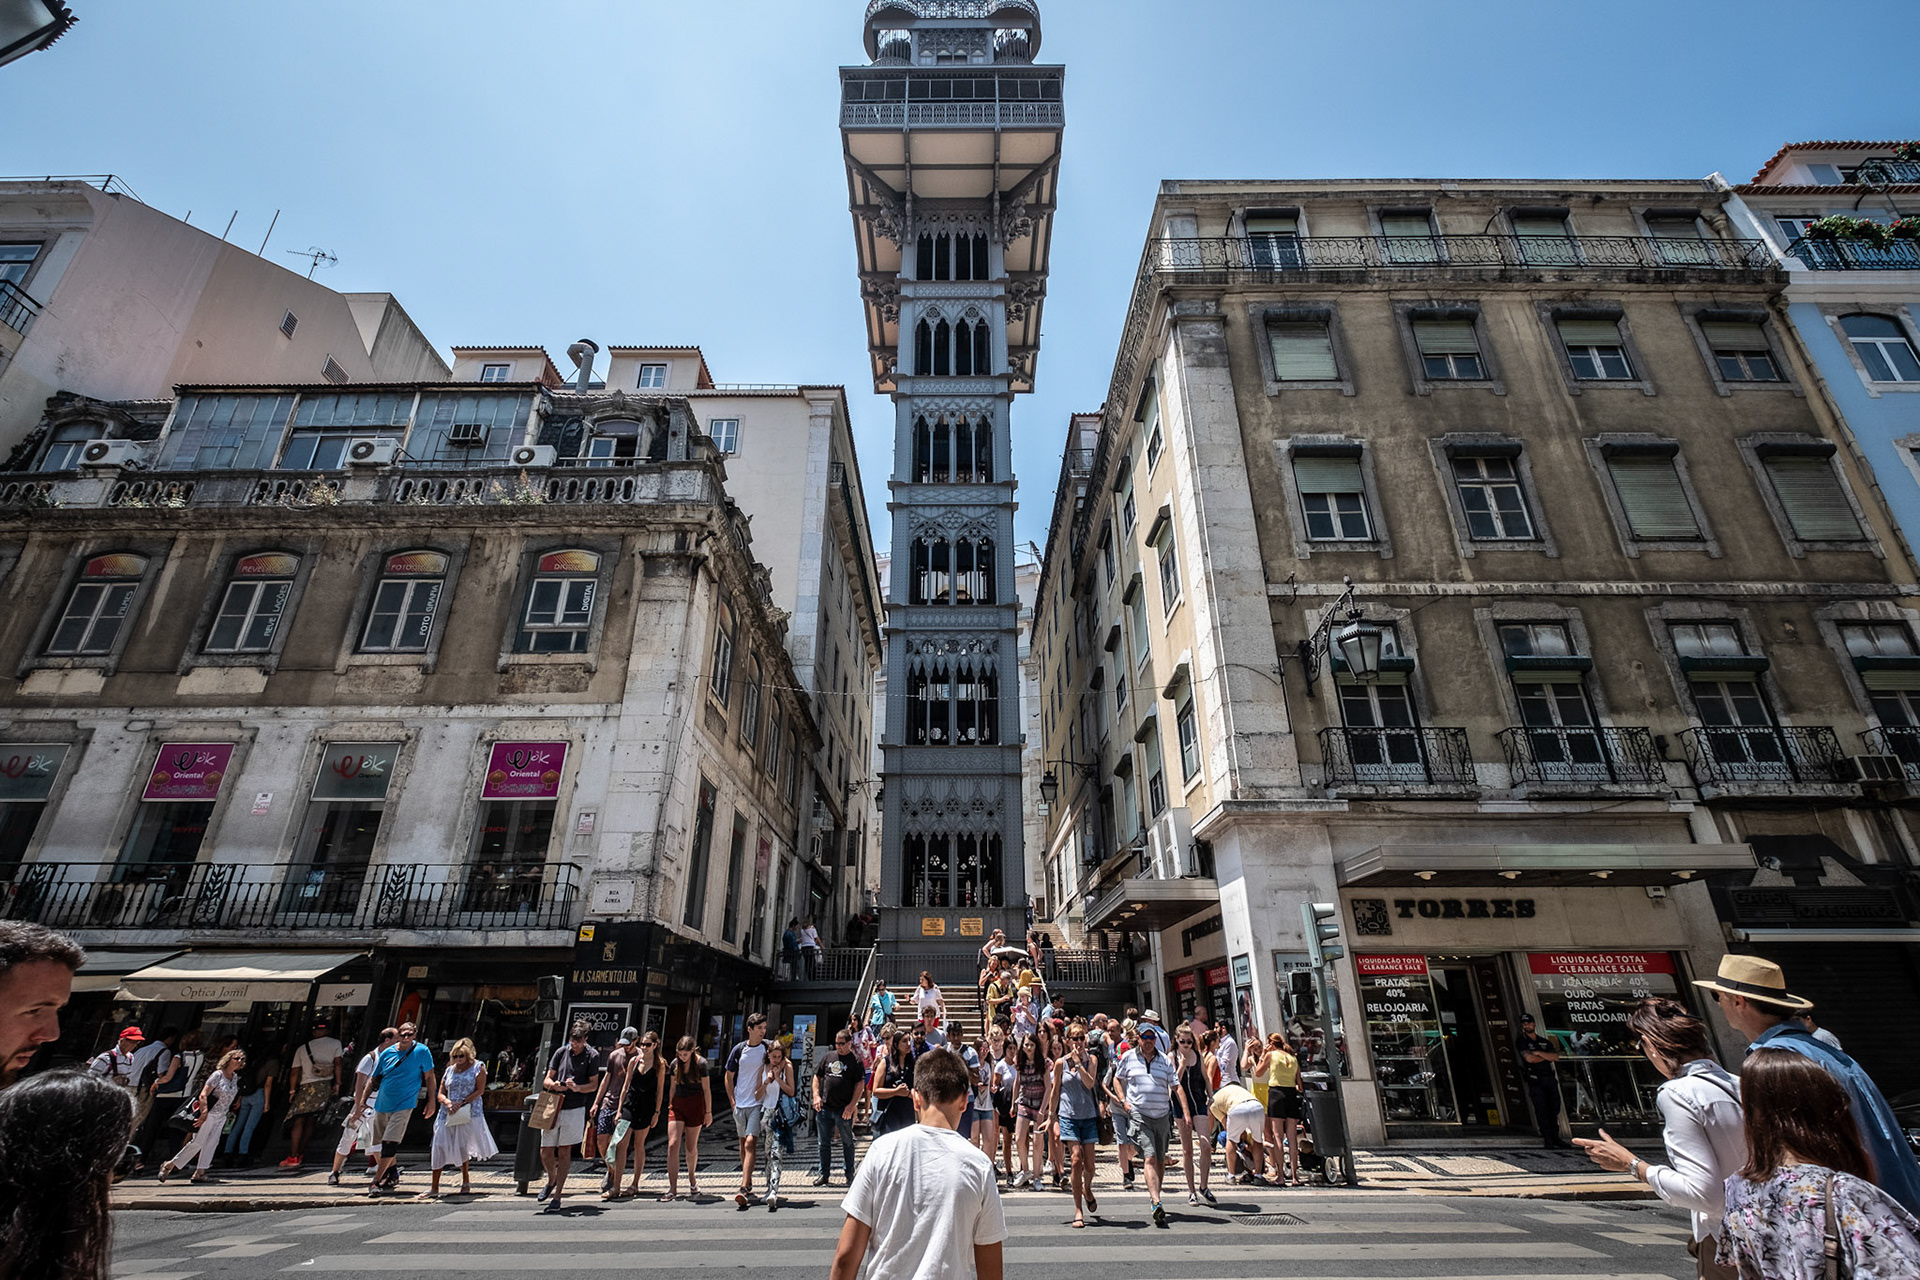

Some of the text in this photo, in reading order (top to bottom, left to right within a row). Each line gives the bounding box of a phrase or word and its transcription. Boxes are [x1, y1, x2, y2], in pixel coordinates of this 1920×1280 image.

[581, 583, 593, 611] DIGITAL
[419, 615, 431, 636] FOTO
[173, 771, 204, 779] Oriental
[509, 770, 541, 778] Oriental
[1394, 899, 1536, 919] TORRES
[1359, 957, 1401, 965] LIQUIDAÇÃO
[1550, 954, 1648, 964] LIQUIDAÇÃO TOTAL
[1558, 965, 1645, 973] CLEARANCE SALE
[1374, 978, 1411, 987] PRATAS
[217, 985, 249, 999] Jomil
[1386, 989, 1406, 997] 40%
[1564, 989, 1653, 999] OURO 50%
[1366, 1003, 1429, 1012] RELOJOARIA
[1567, 1001, 1605, 1011] PRATAS
[574, 1012, 609, 1022] ESPAÇO
[1390, 1013, 1411, 1023] 30%
